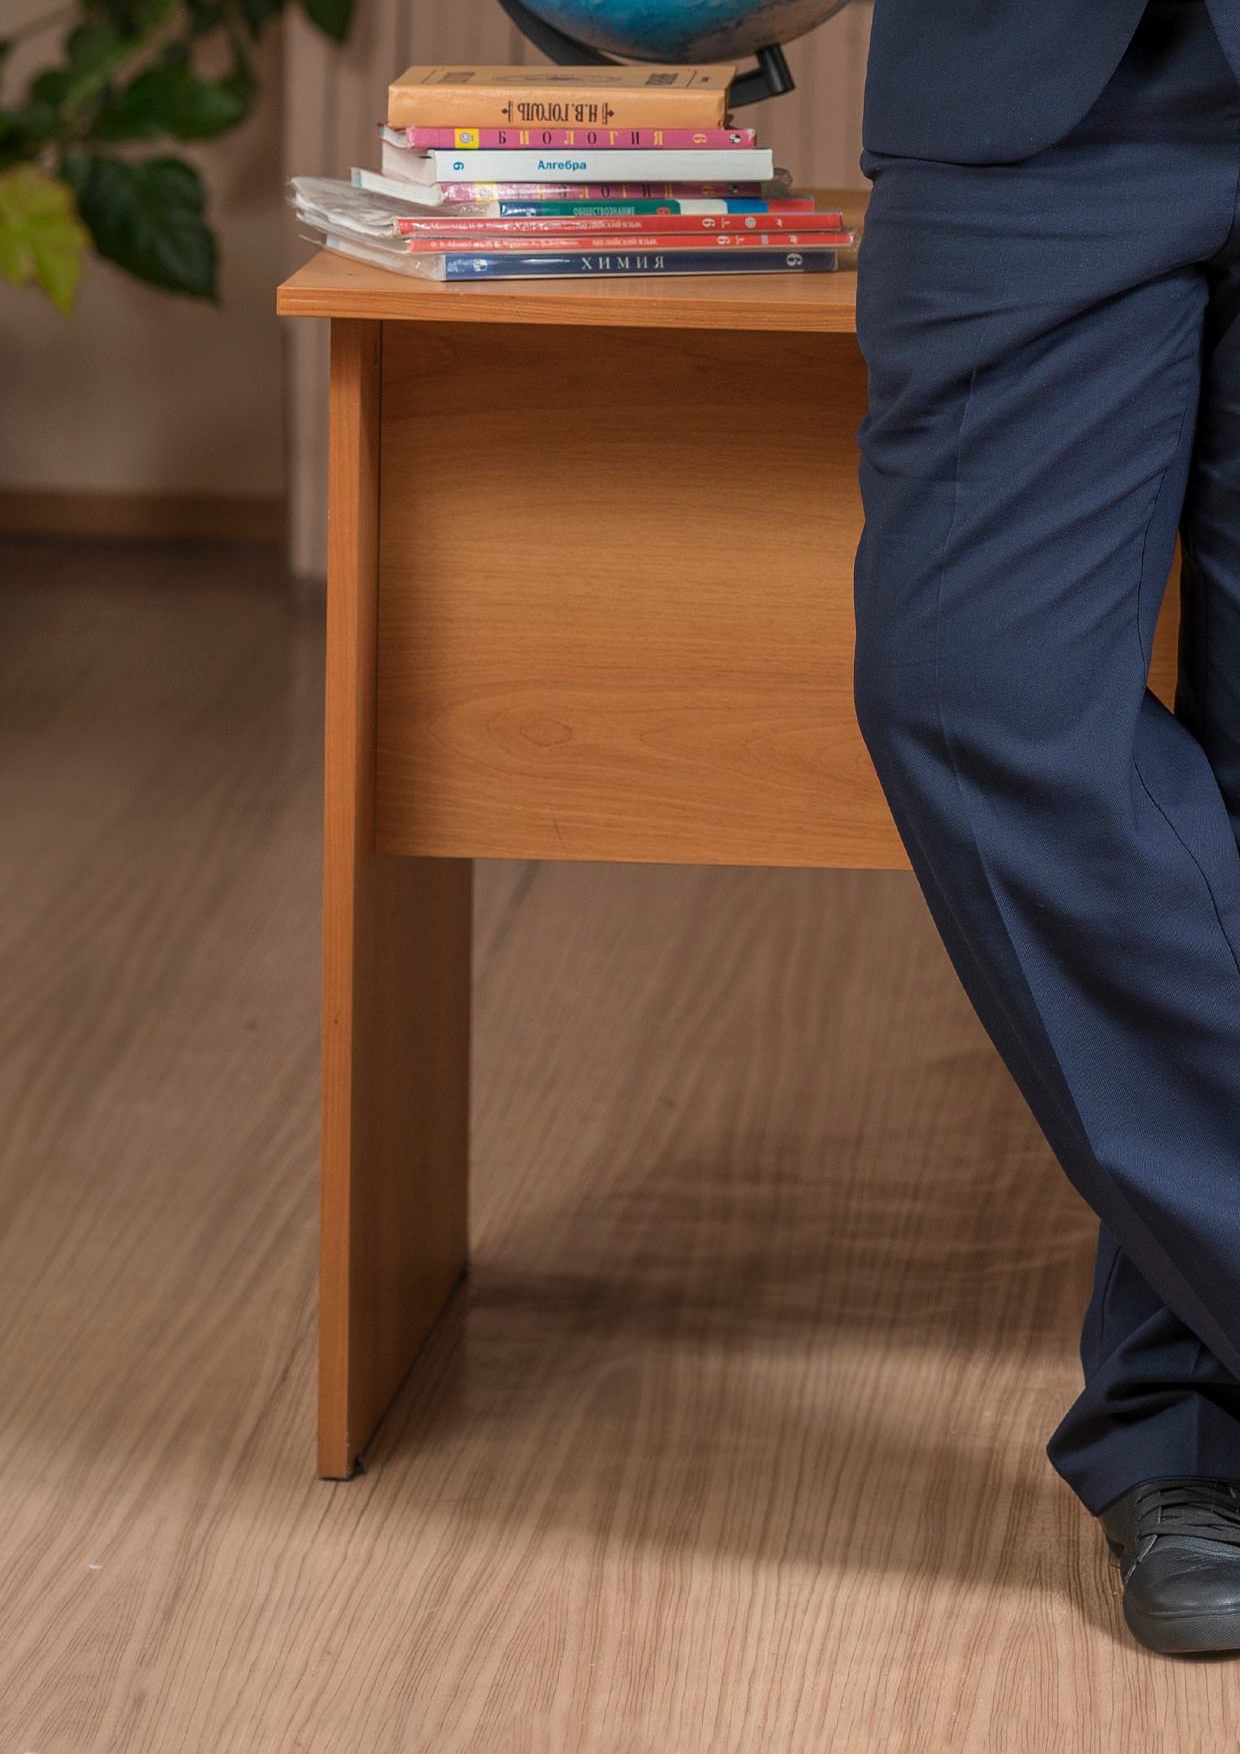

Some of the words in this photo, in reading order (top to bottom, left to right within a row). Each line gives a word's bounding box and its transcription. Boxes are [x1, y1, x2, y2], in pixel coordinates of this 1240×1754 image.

[498, 130, 664, 146] БИОЛОГИЯ
[537, 159, 587, 172] Алгебра
[581, 255, 665, 271] ХИМИЯ
